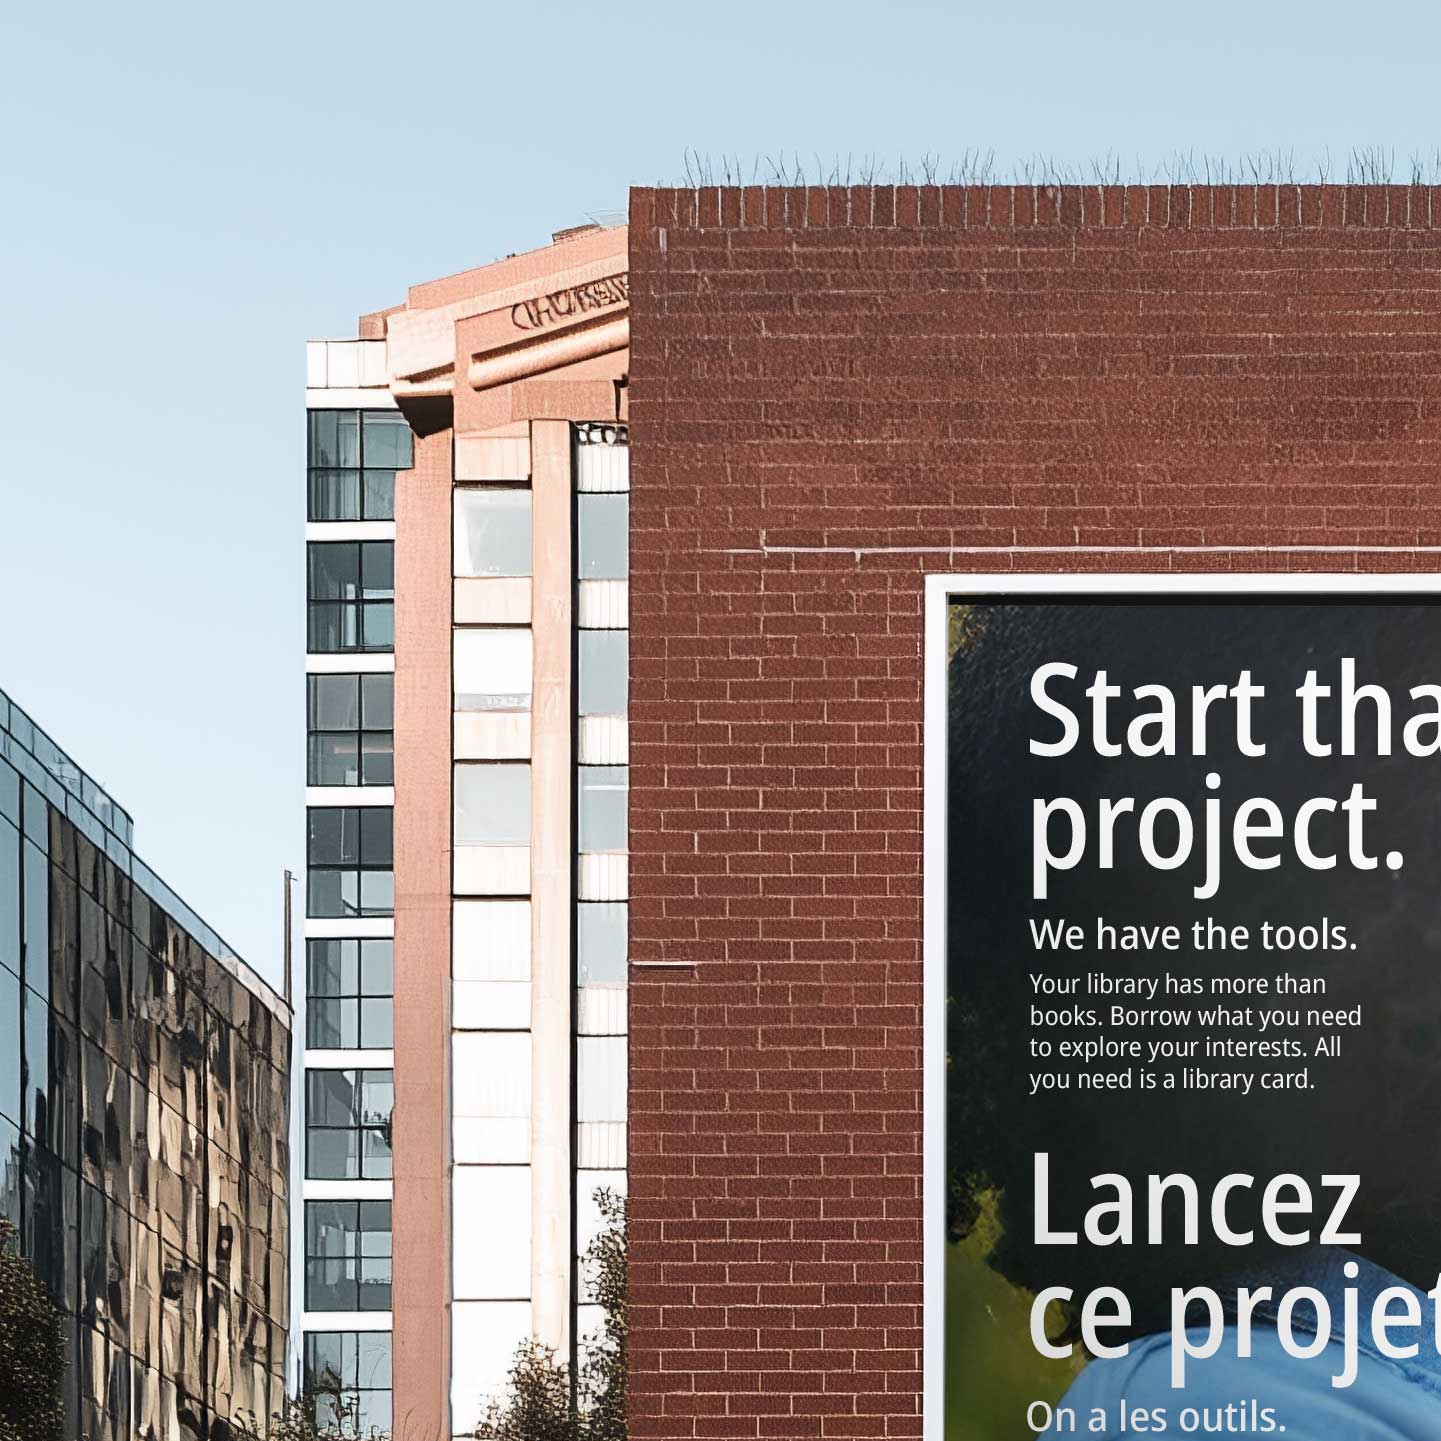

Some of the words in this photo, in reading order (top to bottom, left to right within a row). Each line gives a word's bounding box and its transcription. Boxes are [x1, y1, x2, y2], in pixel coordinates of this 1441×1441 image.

[1029, 661, 1266, 758] Start
[1033, 772, 1404, 900] project.
[1029, 918, 1085, 950] We
[1097, 916, 1181, 951] have
[1191, 916, 1250, 951] the
[1260, 916, 1357, 951] tools.
[1029, 973, 1081, 994] Your
[1087, 972, 1159, 999] library
[1165, 972, 1204, 994] has
[1211, 978, 1269, 994] more
[1274, 972, 1326, 994] than
[1030, 1004, 1103, 1026] books.
[1111, 1005, 1192, 1026] Borrow
[1197, 1004, 1254, 1026] what
[1258, 1009, 1300, 1030] you
[1307, 1004, 1361, 1026] need
[1029, 1038, 1052, 1057] to
[1059, 1035, 1142, 1063] explore
[1147, 1041, 1200, 1063] your
[1206, 1035, 1307, 1057] interests.
[1314, 1035, 1341, 1057] All
[1029, 1073, 1070, 1095] you
[1078, 1067, 1132, 1089] need
[1140, 1068, 1157, 1089] is
[1162, 1073, 1175, 1089] a
[1183, 1067, 1255, 1095] library
[1260, 1067, 1315, 1089] card.
[1034, 1152, 1362, 1246] Lancez
[1030, 1286, 1132, 1359] ce
[1027, 1400, 1075, 1432] On
[1088, 1407, 1106, 1432] a
[1120, 1399, 1167, 1432] les
[1179, 1399, 1286, 1432] outils.
